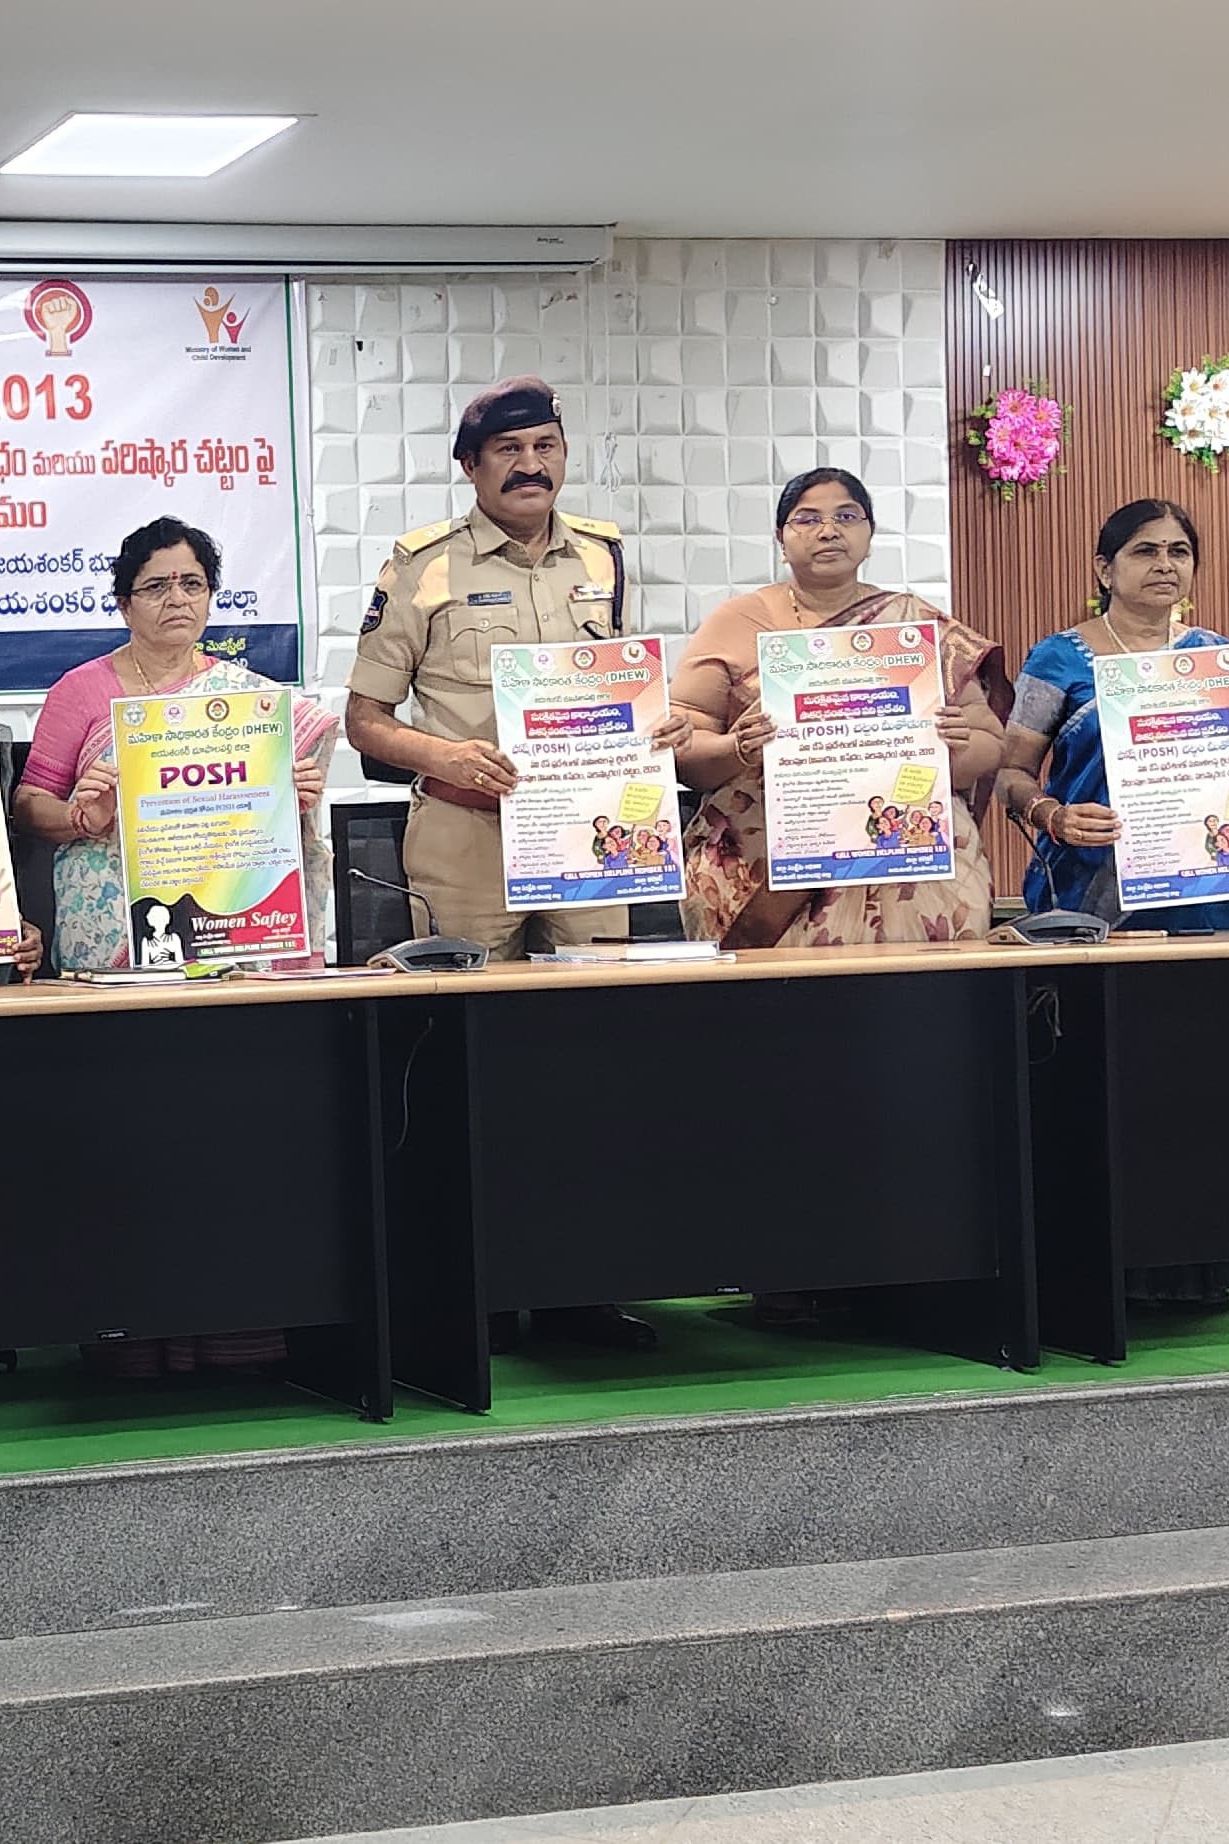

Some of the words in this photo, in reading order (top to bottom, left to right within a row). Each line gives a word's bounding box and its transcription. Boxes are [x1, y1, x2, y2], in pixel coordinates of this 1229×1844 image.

[32, 453, 96, 478] మరియు
[101, 438, 188, 488] పరిష్కార
[193, 437, 250, 491] చట్టం
[254, 437, 277, 486] పై
[216, 589, 259, 618] జిల్లా
[883, 653, 925, 667] (DHEW)
[606, 668, 651, 683] (DHEW)
[242, 722, 283, 737] (DHEW)
[802, 724, 849, 740] (POSH)
[532, 740, 571, 755] (POSH)
[1138, 745, 1179, 761] (POSH)
[159, 760, 247, 789] POSH
[191, 916, 246, 933] Women
[250, 910, 297, 928] Saftey
